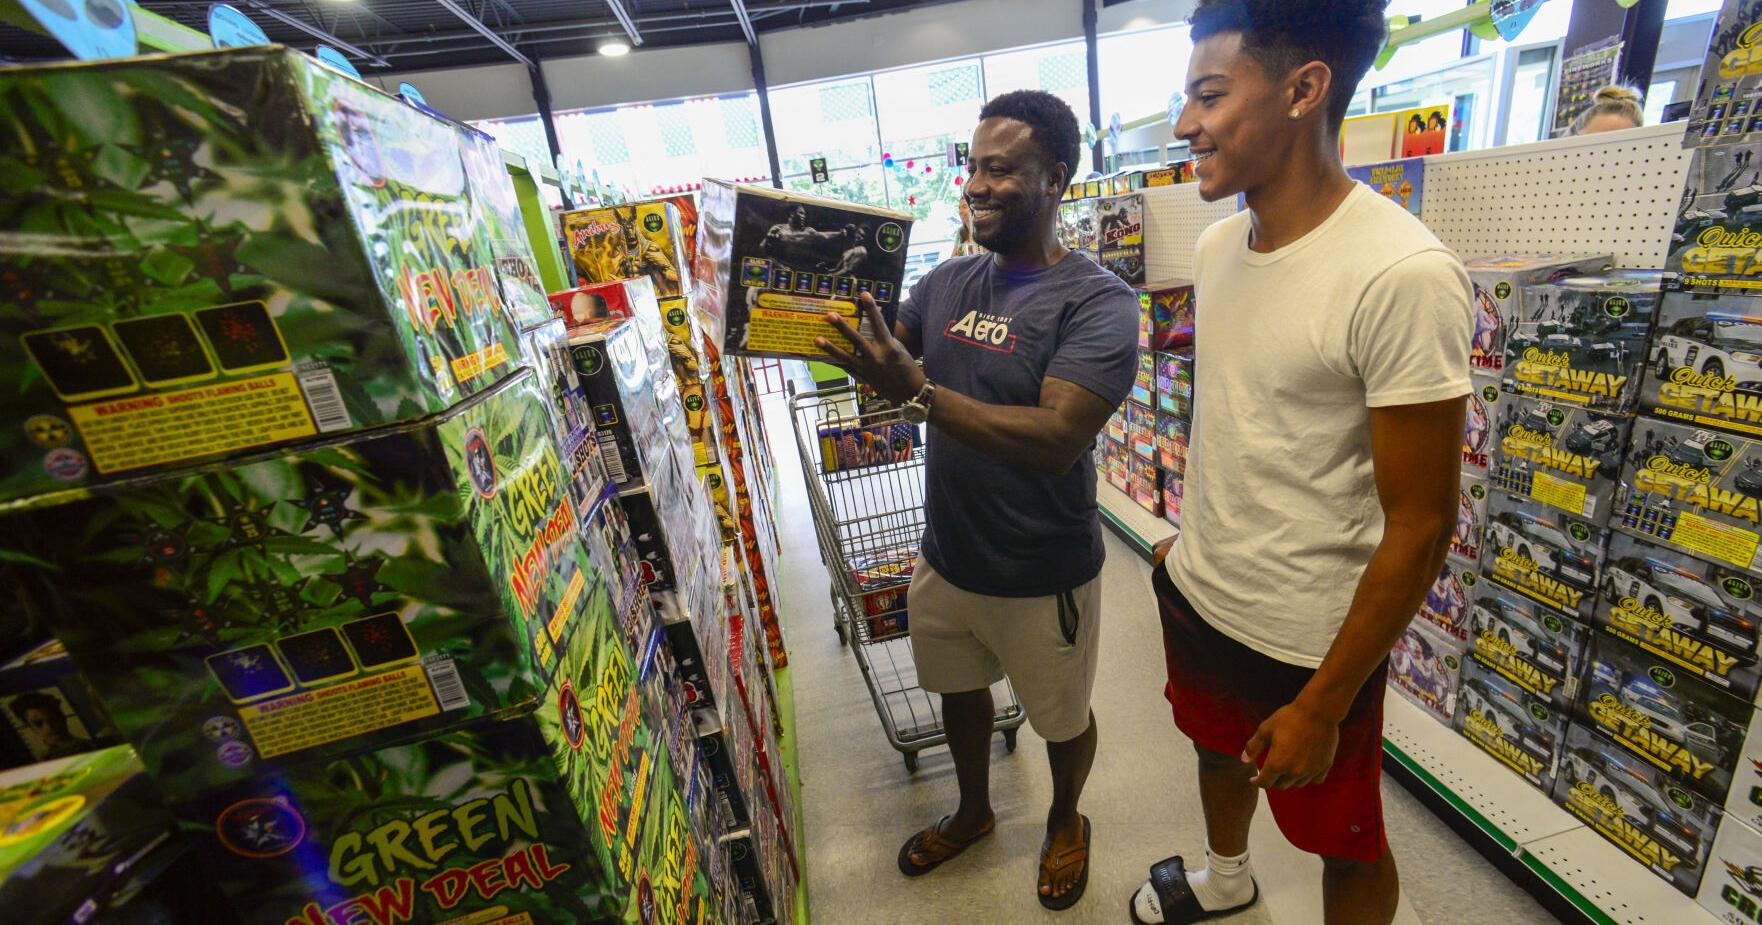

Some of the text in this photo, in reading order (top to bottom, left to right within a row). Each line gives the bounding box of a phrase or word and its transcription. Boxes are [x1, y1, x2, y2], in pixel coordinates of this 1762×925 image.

[816, 173, 825, 182] 2
[1697, 226, 1762, 250] Quic
[950, 310, 1008, 345] Aero
[1523, 346, 1570, 368] Quick
[93, 378, 276, 416] WARNING SHOOTS FLAMING BALLS
[1515, 359, 1628, 398] GETAWAY
[1670, 365, 1737, 393] Quick
[1655, 407, 1695, 421] 500 GRAMS
[1508, 424, 1551, 447] Quick
[1502, 436, 1600, 480] GETAWAY
[1646, 455, 1712, 484] Quick
[1635, 468, 1762, 524] GETAWA
[511, 529, 549, 621] NEW
[1500, 547, 1539, 571] Quick
[1494, 556, 1583, 608] GETAWAY
[1618, 596, 1673, 628] Quick
[1608, 607, 1739, 676] GETAWAY
[1474, 638, 1557, 694] GETAWAY
[258, 671, 406, 713] WARNING SHOOTS FLAMING BALLS
[1600, 693, 1652, 729] Quick
[1465, 716, 1544, 775] GETAWAY
[1588, 701, 1714, 780] GETAWAY
[1576, 781, 1625, 819] Quick
[328, 778, 540, 886] GREEN
[1568, 788, 1681, 871] GETAWAY
[420, 843, 570, 908] DEAL
